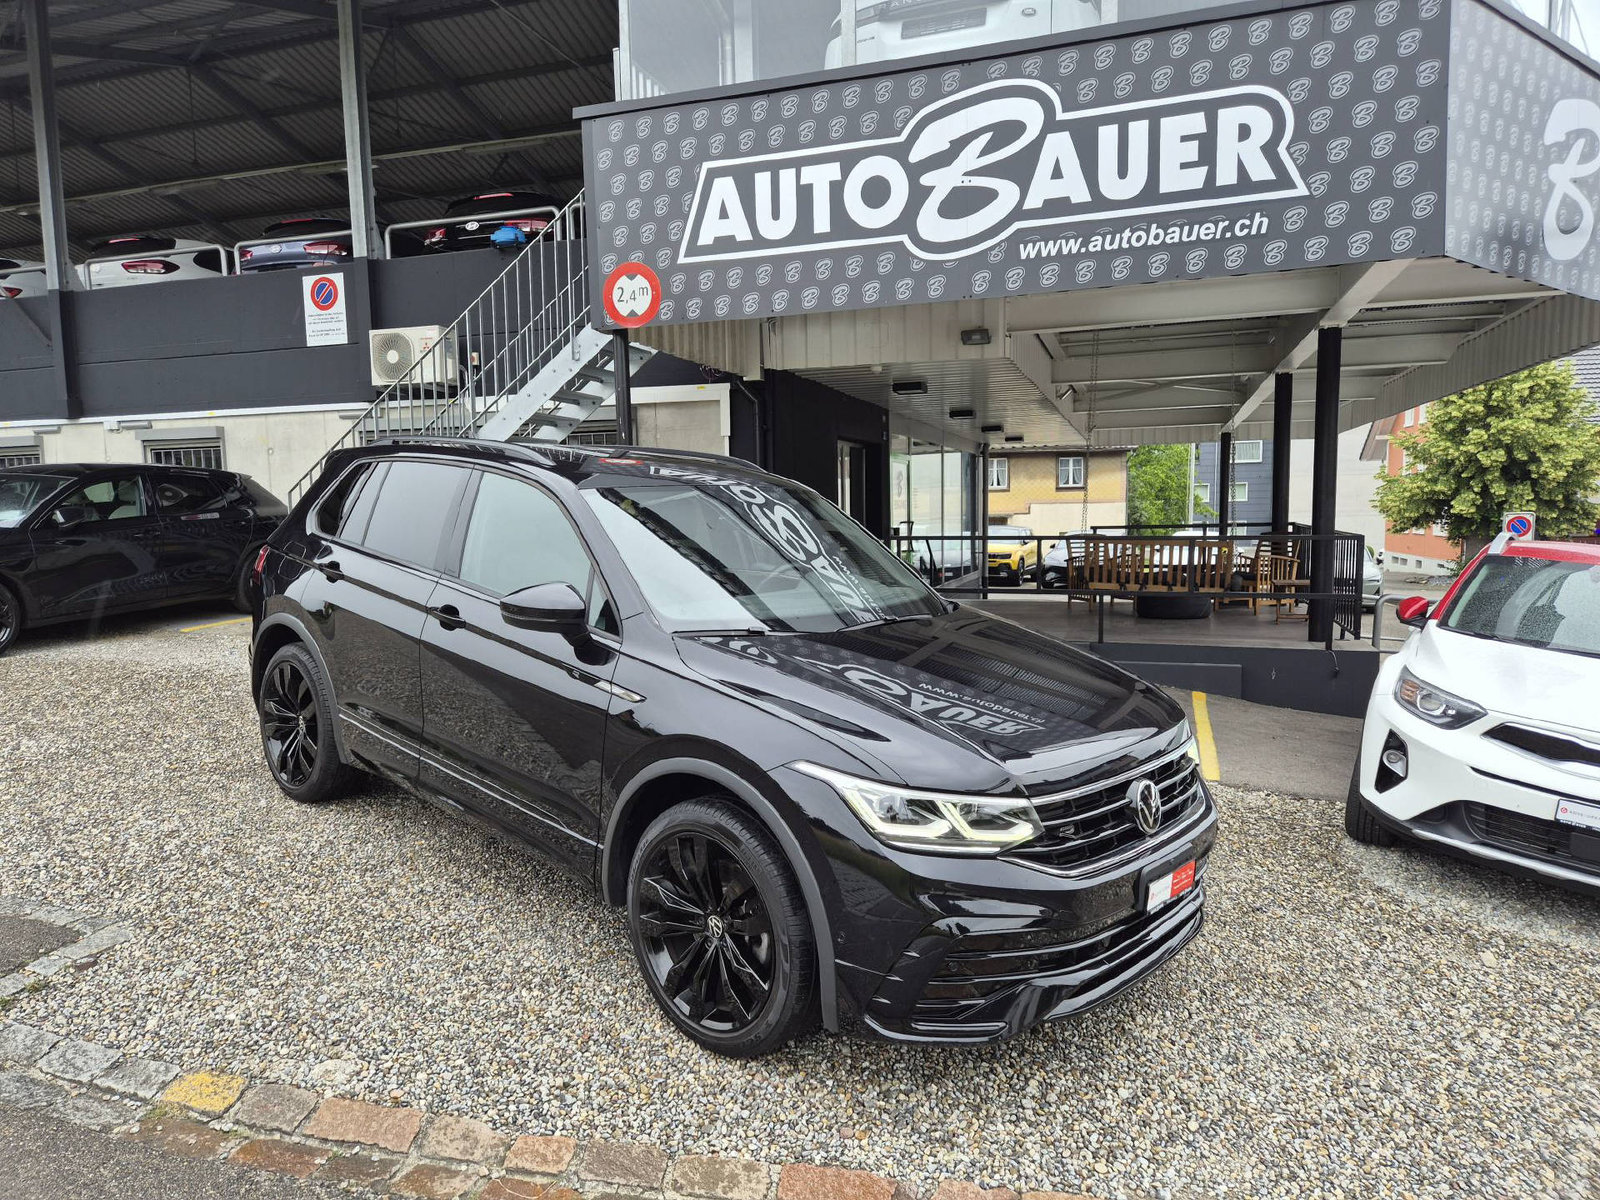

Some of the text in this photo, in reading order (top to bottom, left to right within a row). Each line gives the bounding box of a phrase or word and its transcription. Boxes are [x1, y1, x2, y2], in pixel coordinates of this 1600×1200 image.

[697, 97, 1276, 246] AUTO BAUER
[1019, 212, 1269, 259] www.autobauer.ch
